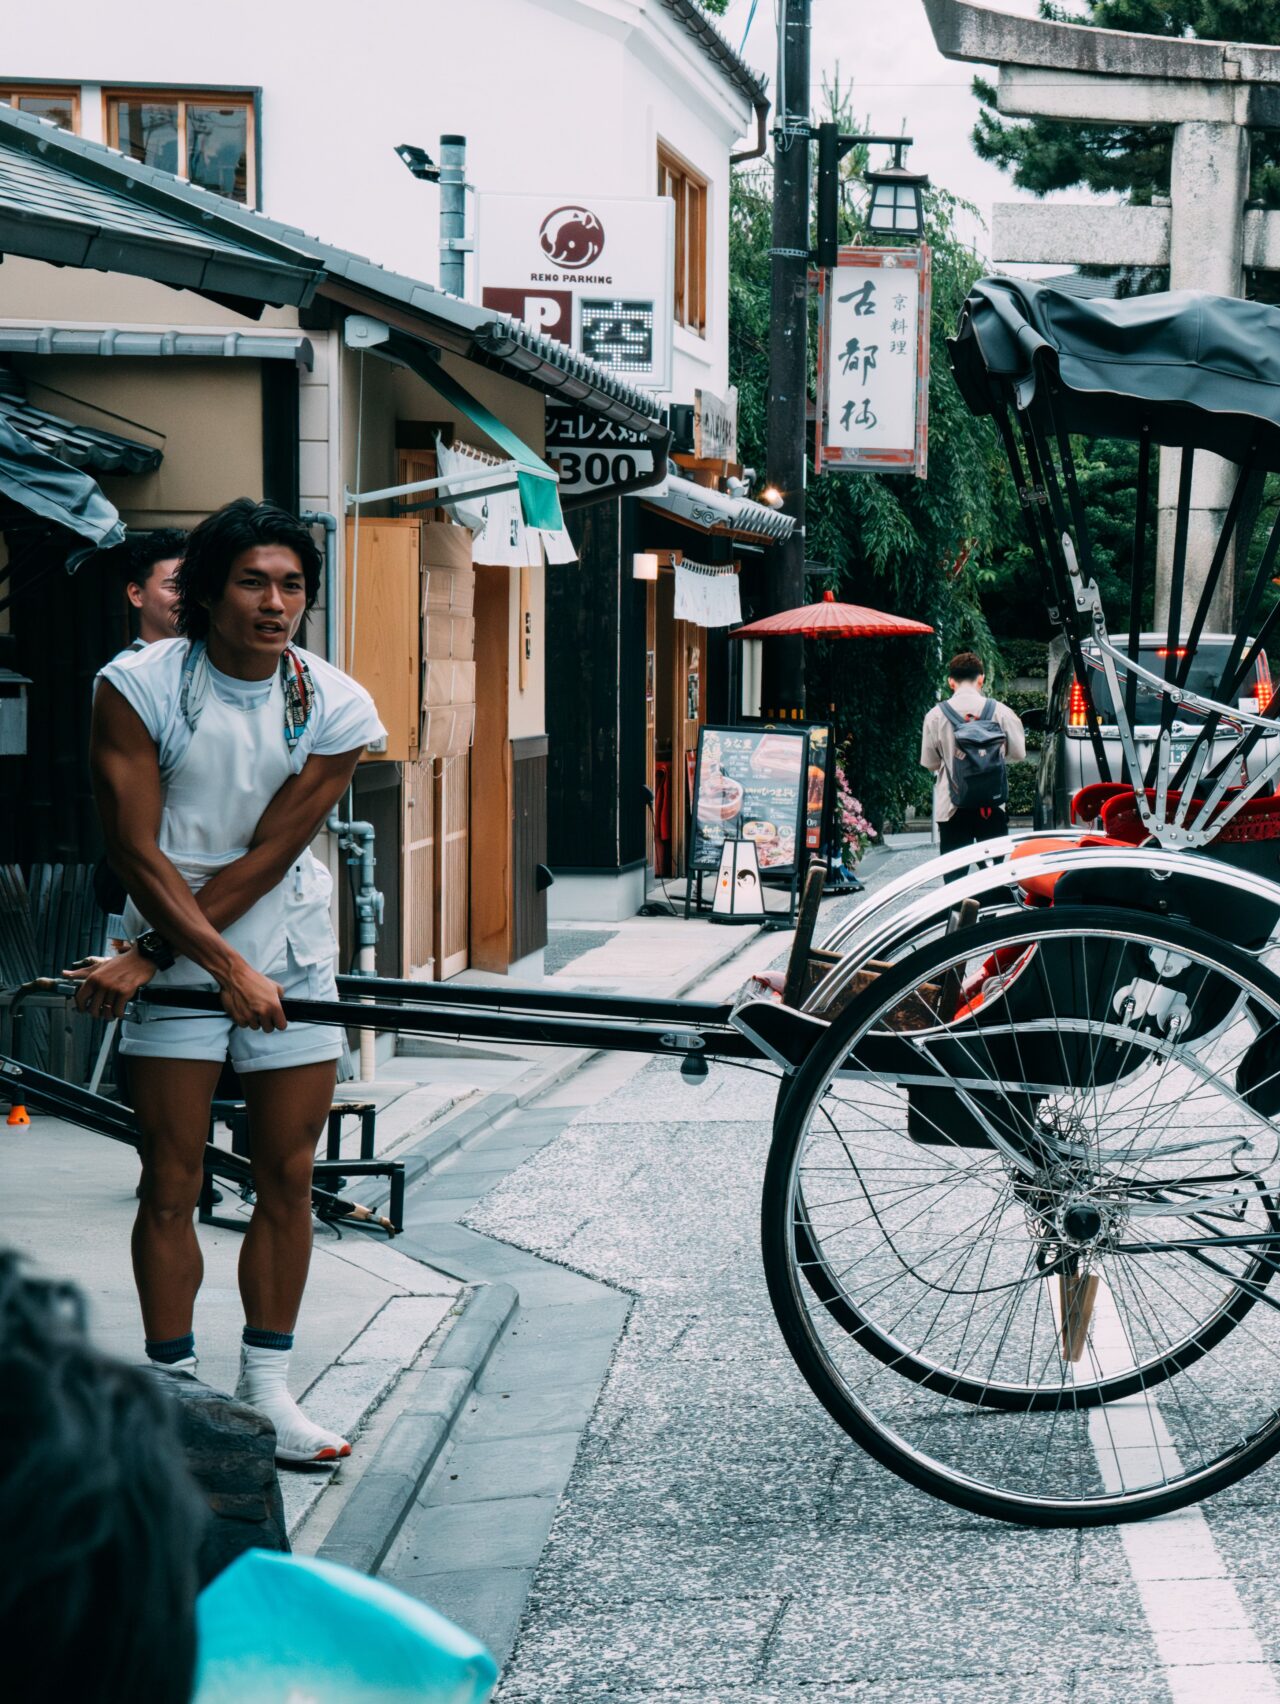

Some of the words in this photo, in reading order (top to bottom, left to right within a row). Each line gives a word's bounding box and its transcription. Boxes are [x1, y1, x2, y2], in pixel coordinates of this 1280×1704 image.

[530, 273, 559, 282] RENO
[562, 275, 613, 285] PARKING
[523, 296, 562, 336] P
[582, 301, 654, 373] 空
[889, 293, 909, 356] 京料理
[837, 279, 879, 433] 古都梅
